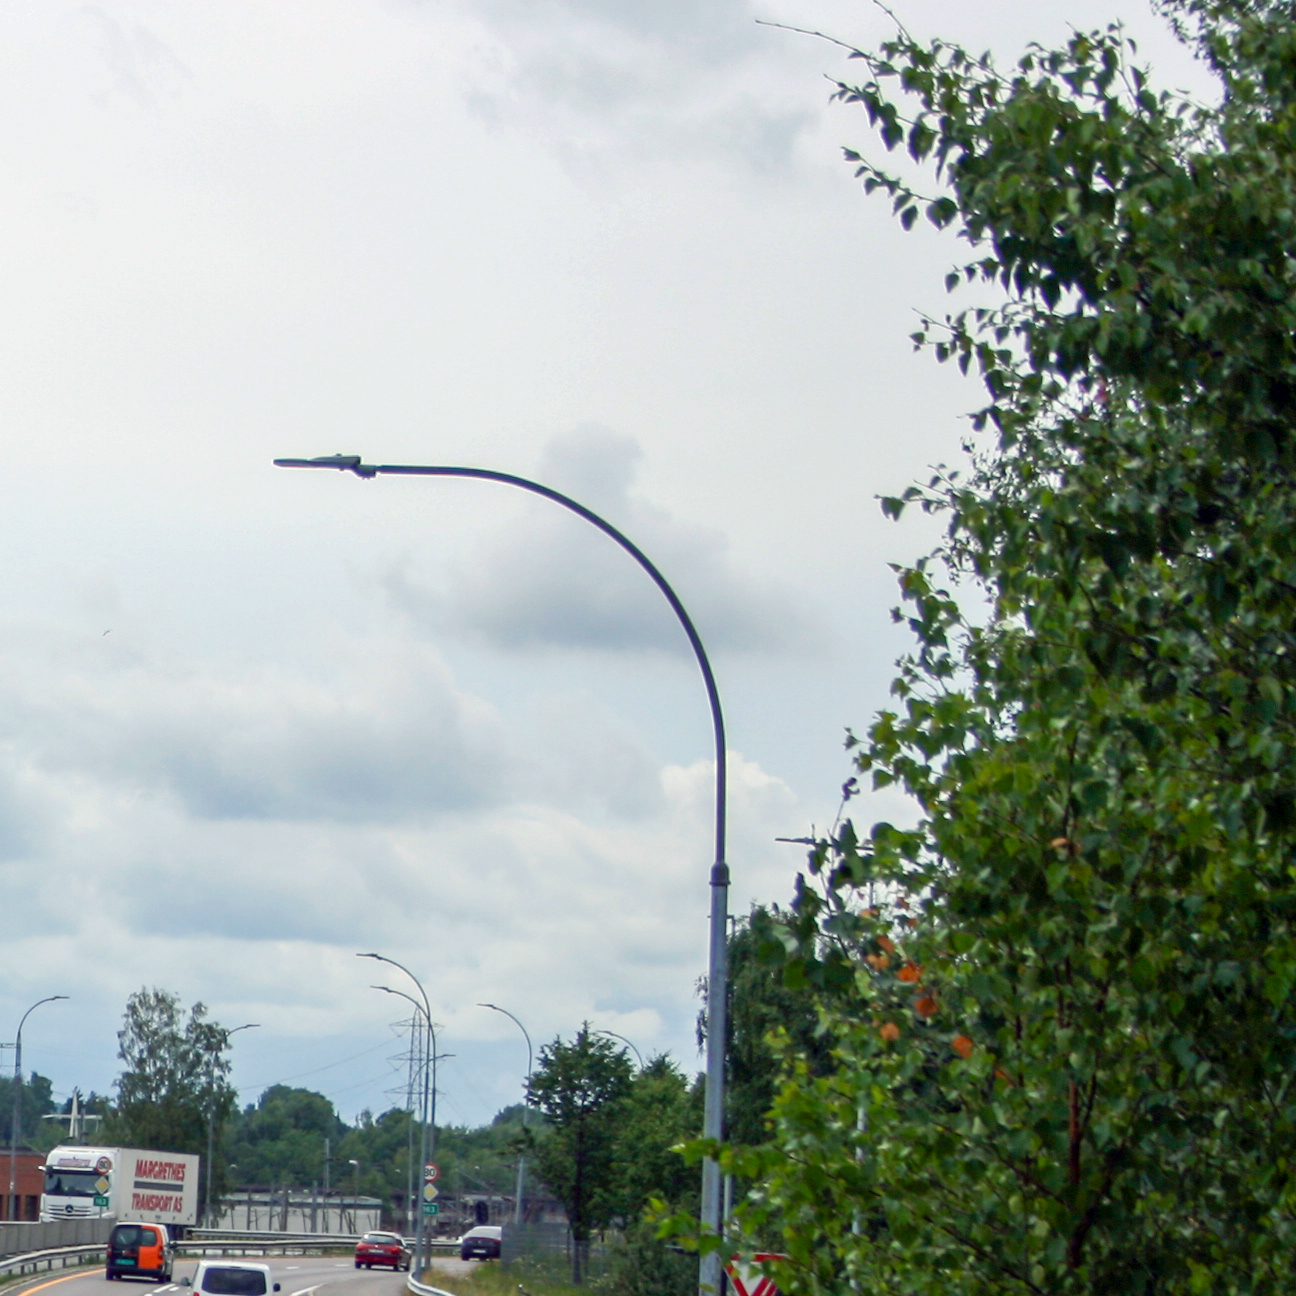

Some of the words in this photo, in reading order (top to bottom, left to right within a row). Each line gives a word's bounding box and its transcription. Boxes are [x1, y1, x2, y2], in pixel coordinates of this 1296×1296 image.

[135, 1159, 186, 1182] MARGRETHES
[132, 1193, 173, 1213] TRANSPORT
[173, 1196, 183, 1213] AS
